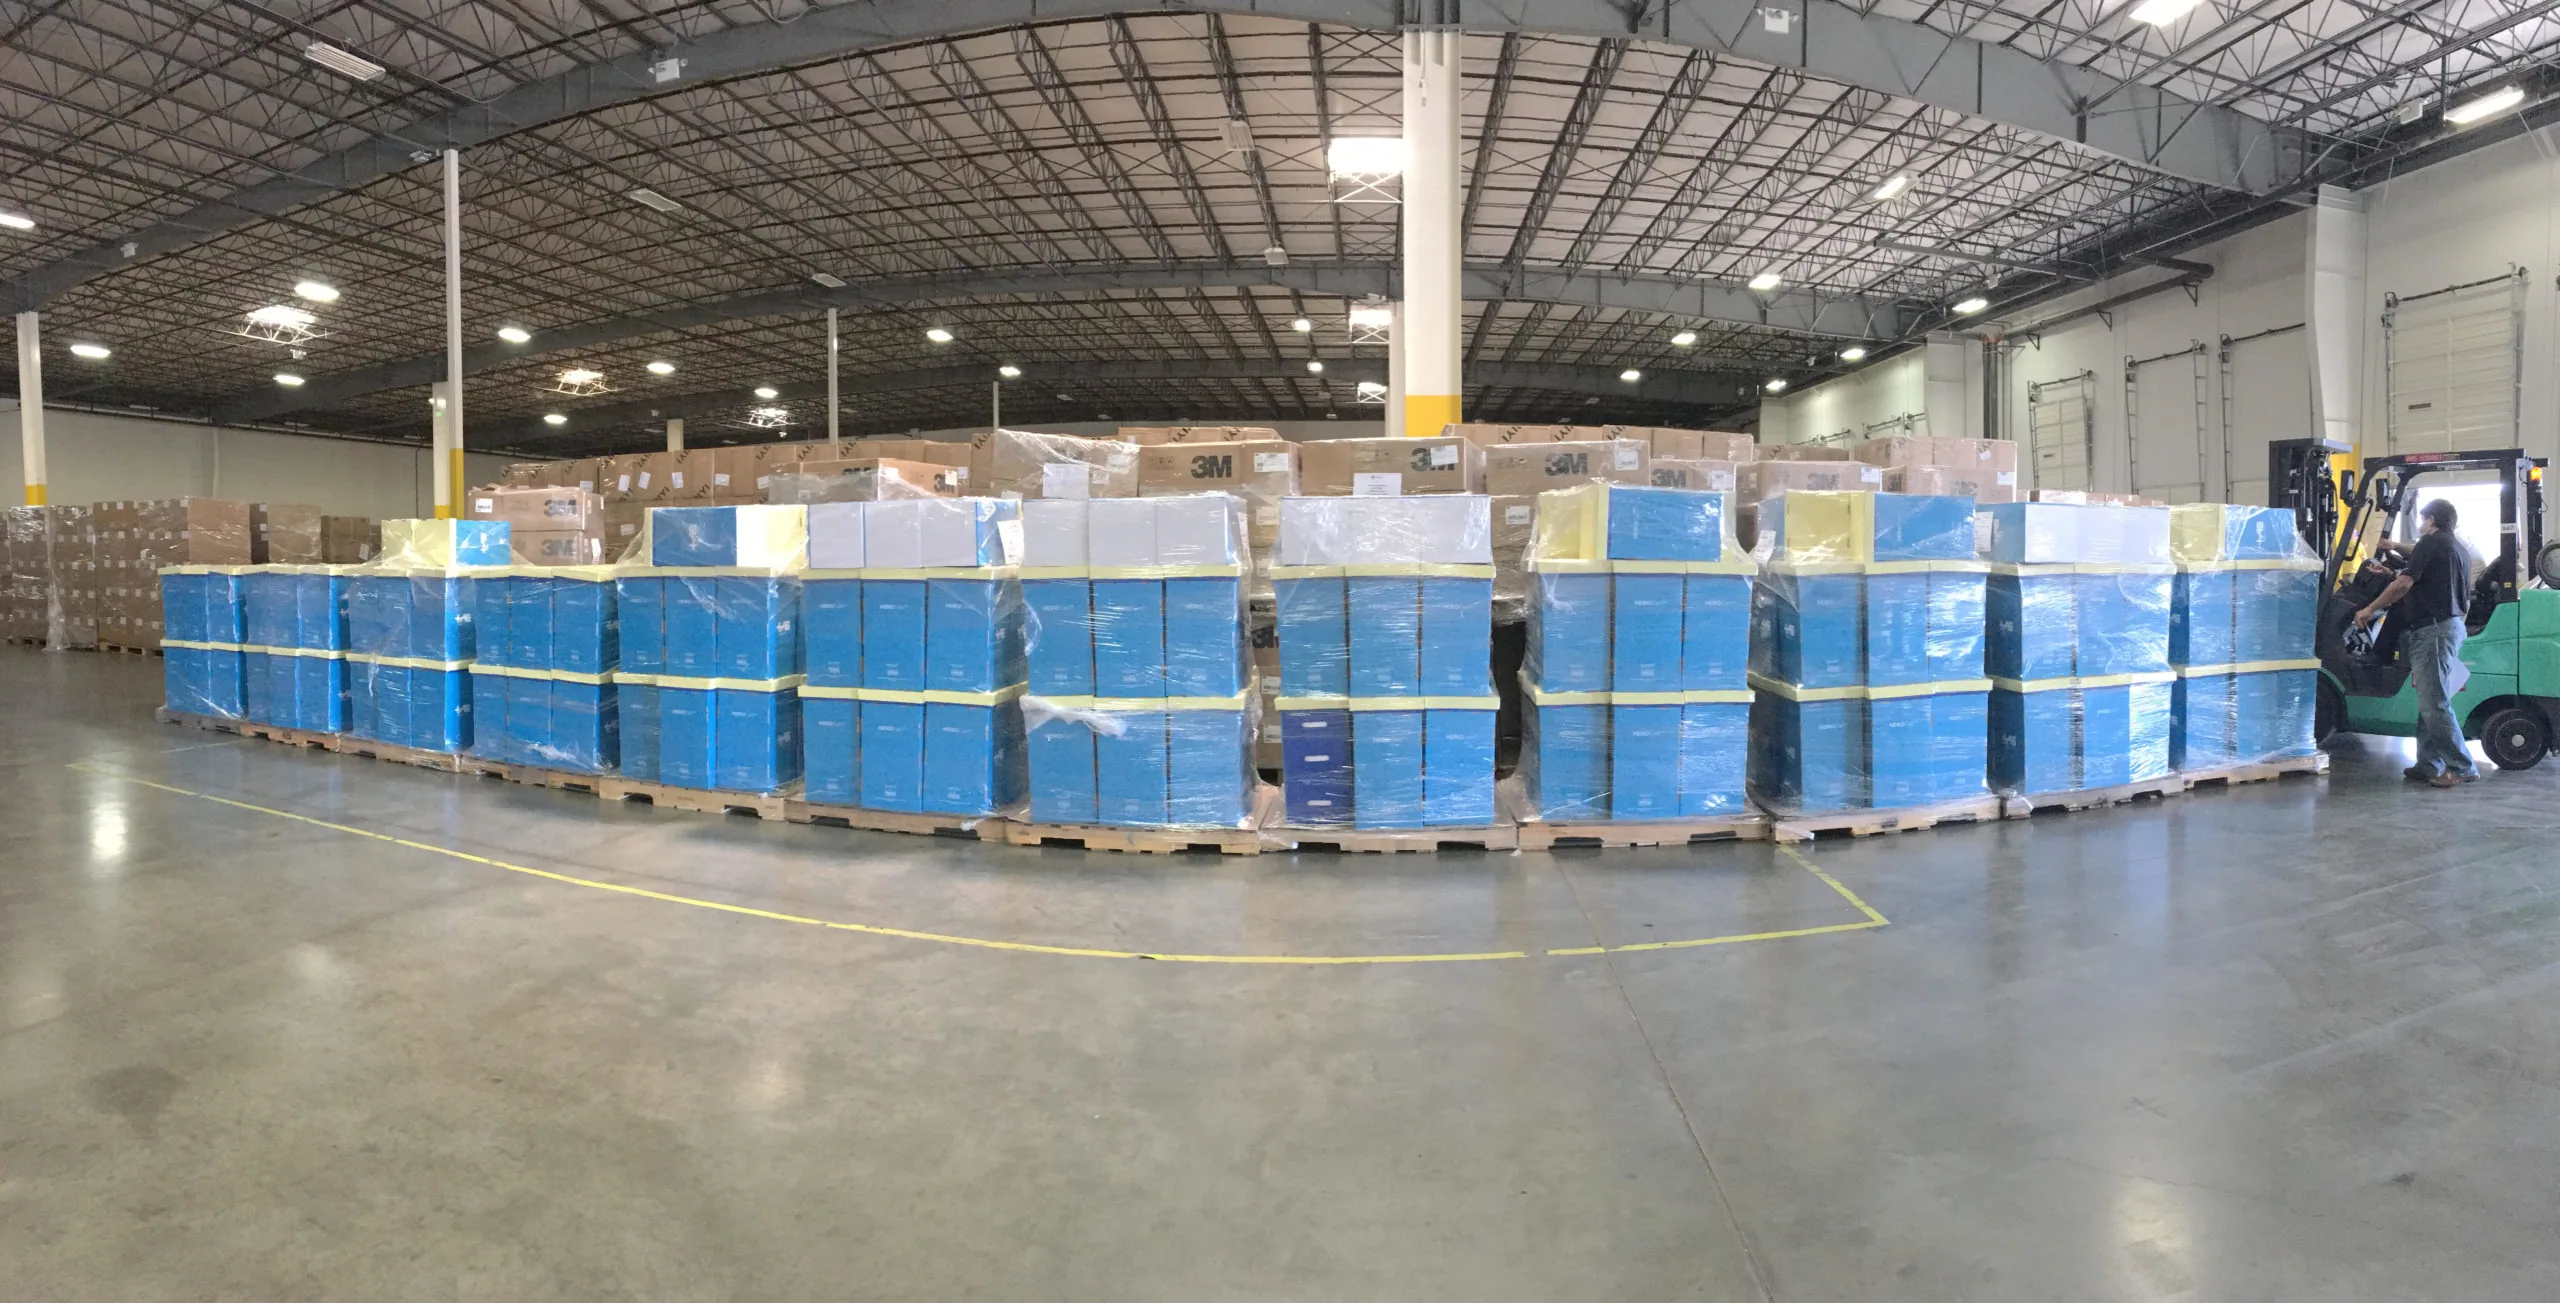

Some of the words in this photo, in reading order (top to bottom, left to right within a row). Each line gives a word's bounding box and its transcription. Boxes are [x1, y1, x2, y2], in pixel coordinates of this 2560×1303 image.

[1190, 455, 1233, 479] 3M
[1544, 452, 1589, 477] 3M
[1650, 468, 1687, 488] 3M
[540, 539, 577, 557] 3M
